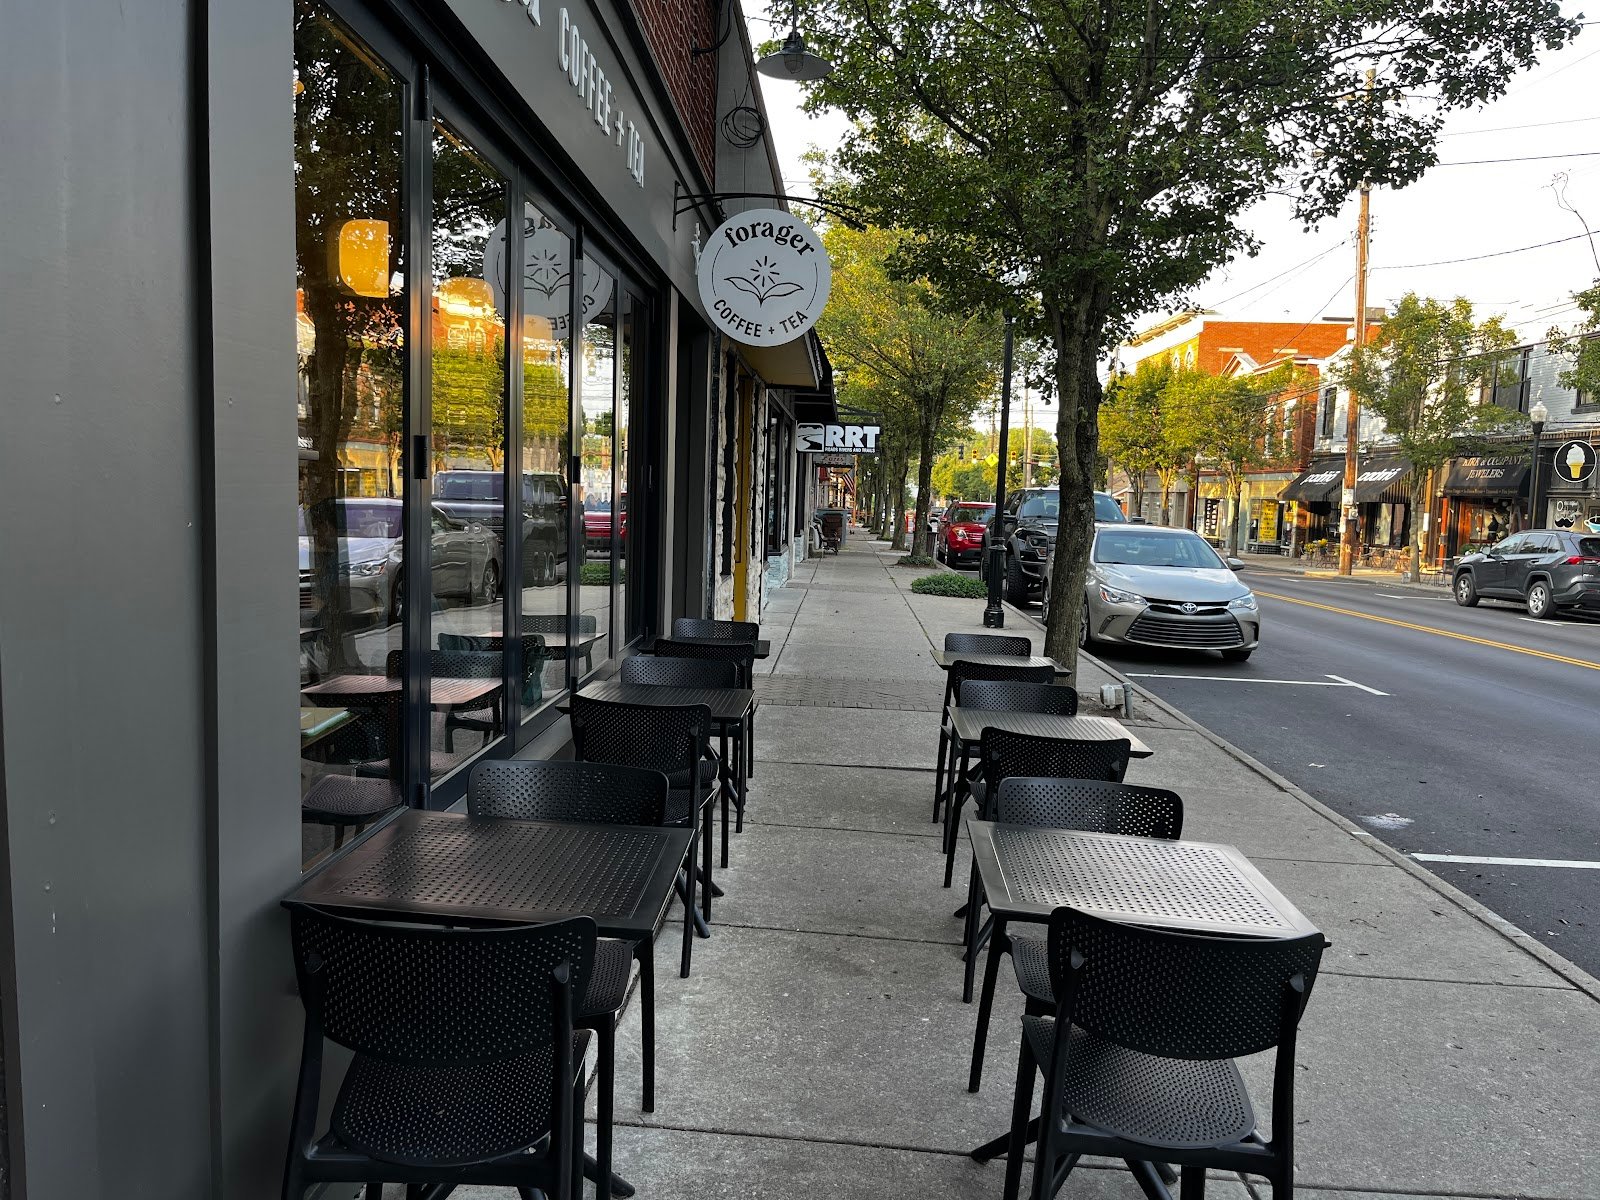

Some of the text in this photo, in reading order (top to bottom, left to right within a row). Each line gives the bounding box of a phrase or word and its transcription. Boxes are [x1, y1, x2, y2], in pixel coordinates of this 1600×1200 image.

[559, 8, 611, 136] COFFEE
[627, 120, 645, 188] TEA
[724, 221, 815, 256] forager
[713, 299, 762, 338] COFFEE
[779, 310, 808, 334] TEA
[825, 425, 880, 448] RRT
[1466, 469, 1505, 481] JEWELERS
